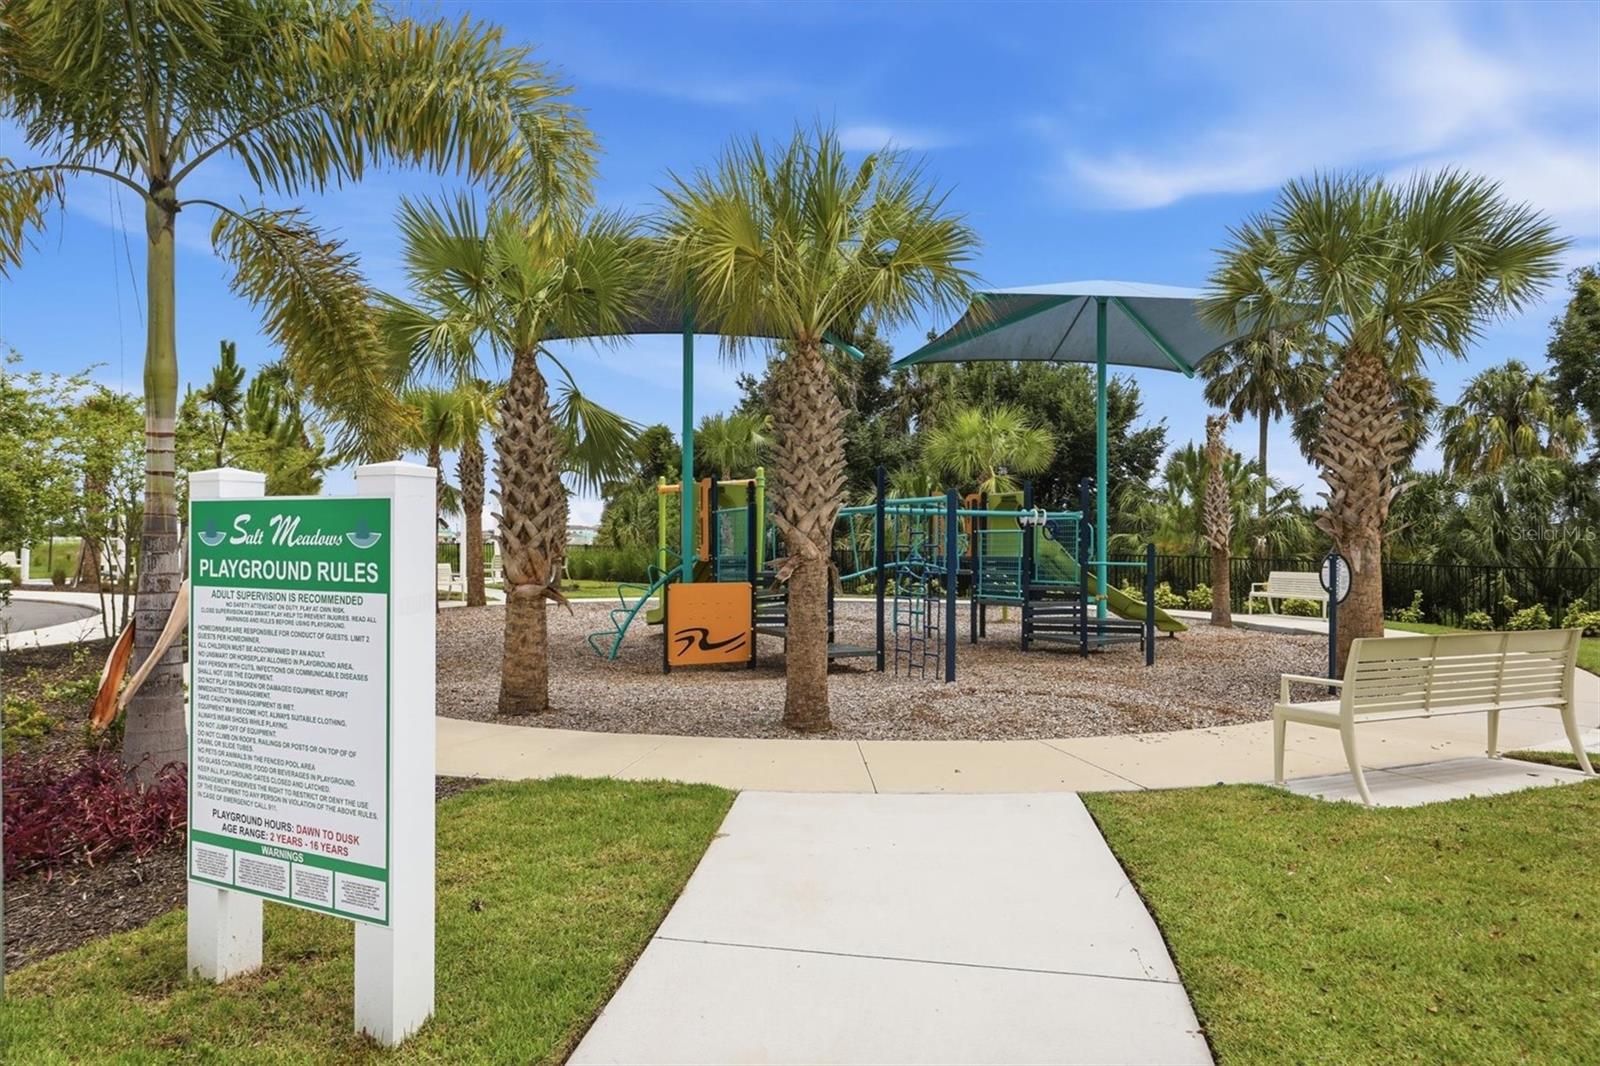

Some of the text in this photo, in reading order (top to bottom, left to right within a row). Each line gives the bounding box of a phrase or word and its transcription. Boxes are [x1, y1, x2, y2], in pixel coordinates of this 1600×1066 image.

[230, 514, 343, 547] Salt Meadows
[199, 559, 379, 583] PLAYGROUND RULES
[211, 589, 363, 605] ADULT SUPERVISION IS RECOMMENDED
[212, 808, 359, 846] PLAYGROUND HOURS: DAWN TO DUSK
[221, 822, 236, 834] AGE
[238, 825, 267, 840] RANGE:
[270, 831, 274, 841] 2
[276, 833, 302, 847] YEARS
[309, 839, 318, 850] 16
[320, 841, 348, 856] YEARS
[260, 845, 305, 863] WARNINGS
